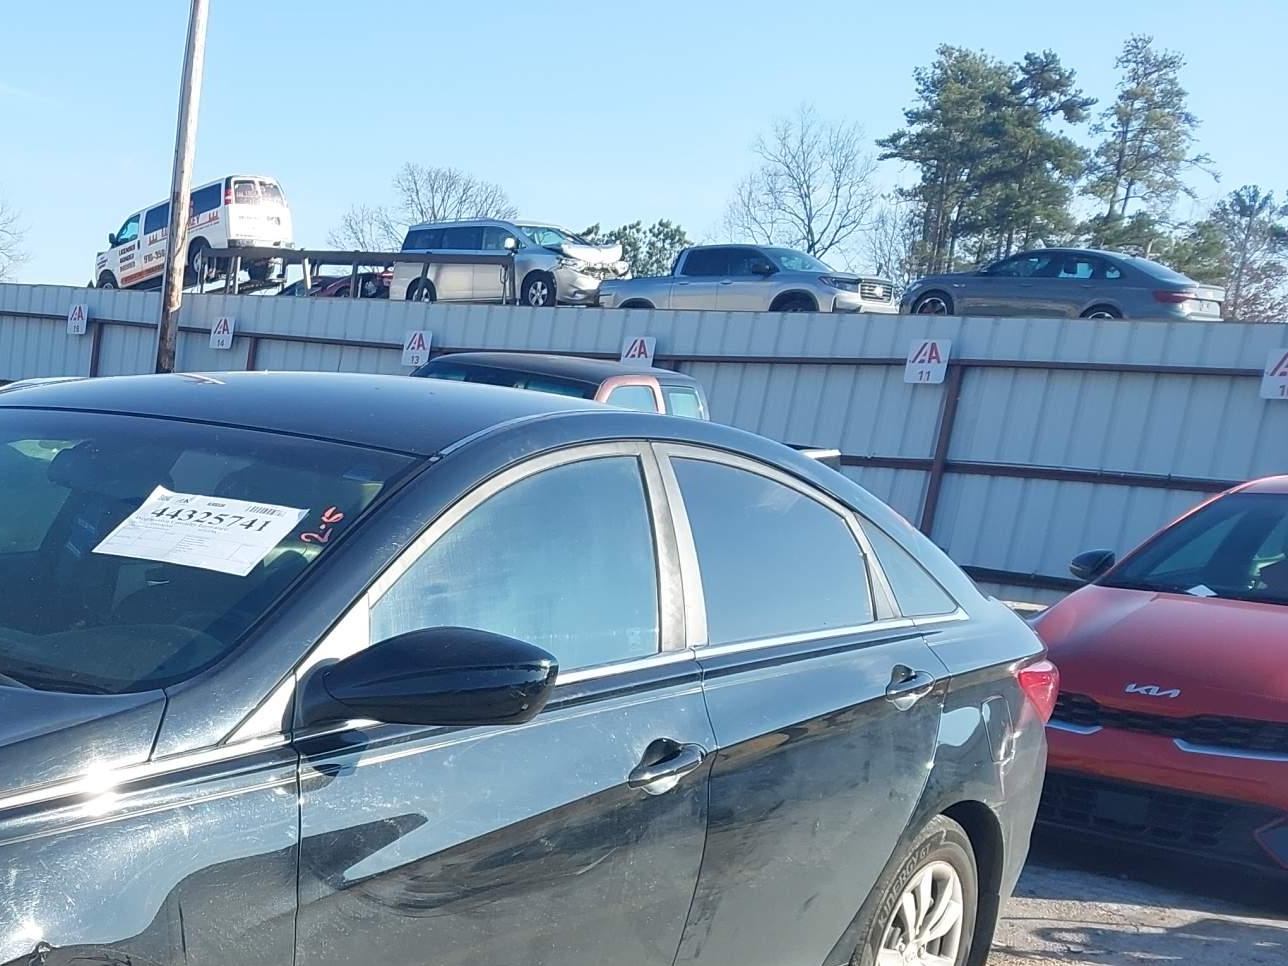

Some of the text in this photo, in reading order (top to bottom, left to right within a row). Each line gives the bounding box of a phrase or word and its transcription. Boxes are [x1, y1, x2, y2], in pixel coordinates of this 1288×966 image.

[412, 355, 419, 364] 13
[918, 370, 931, 381] 11
[151, 506, 272, 532] 44325741
